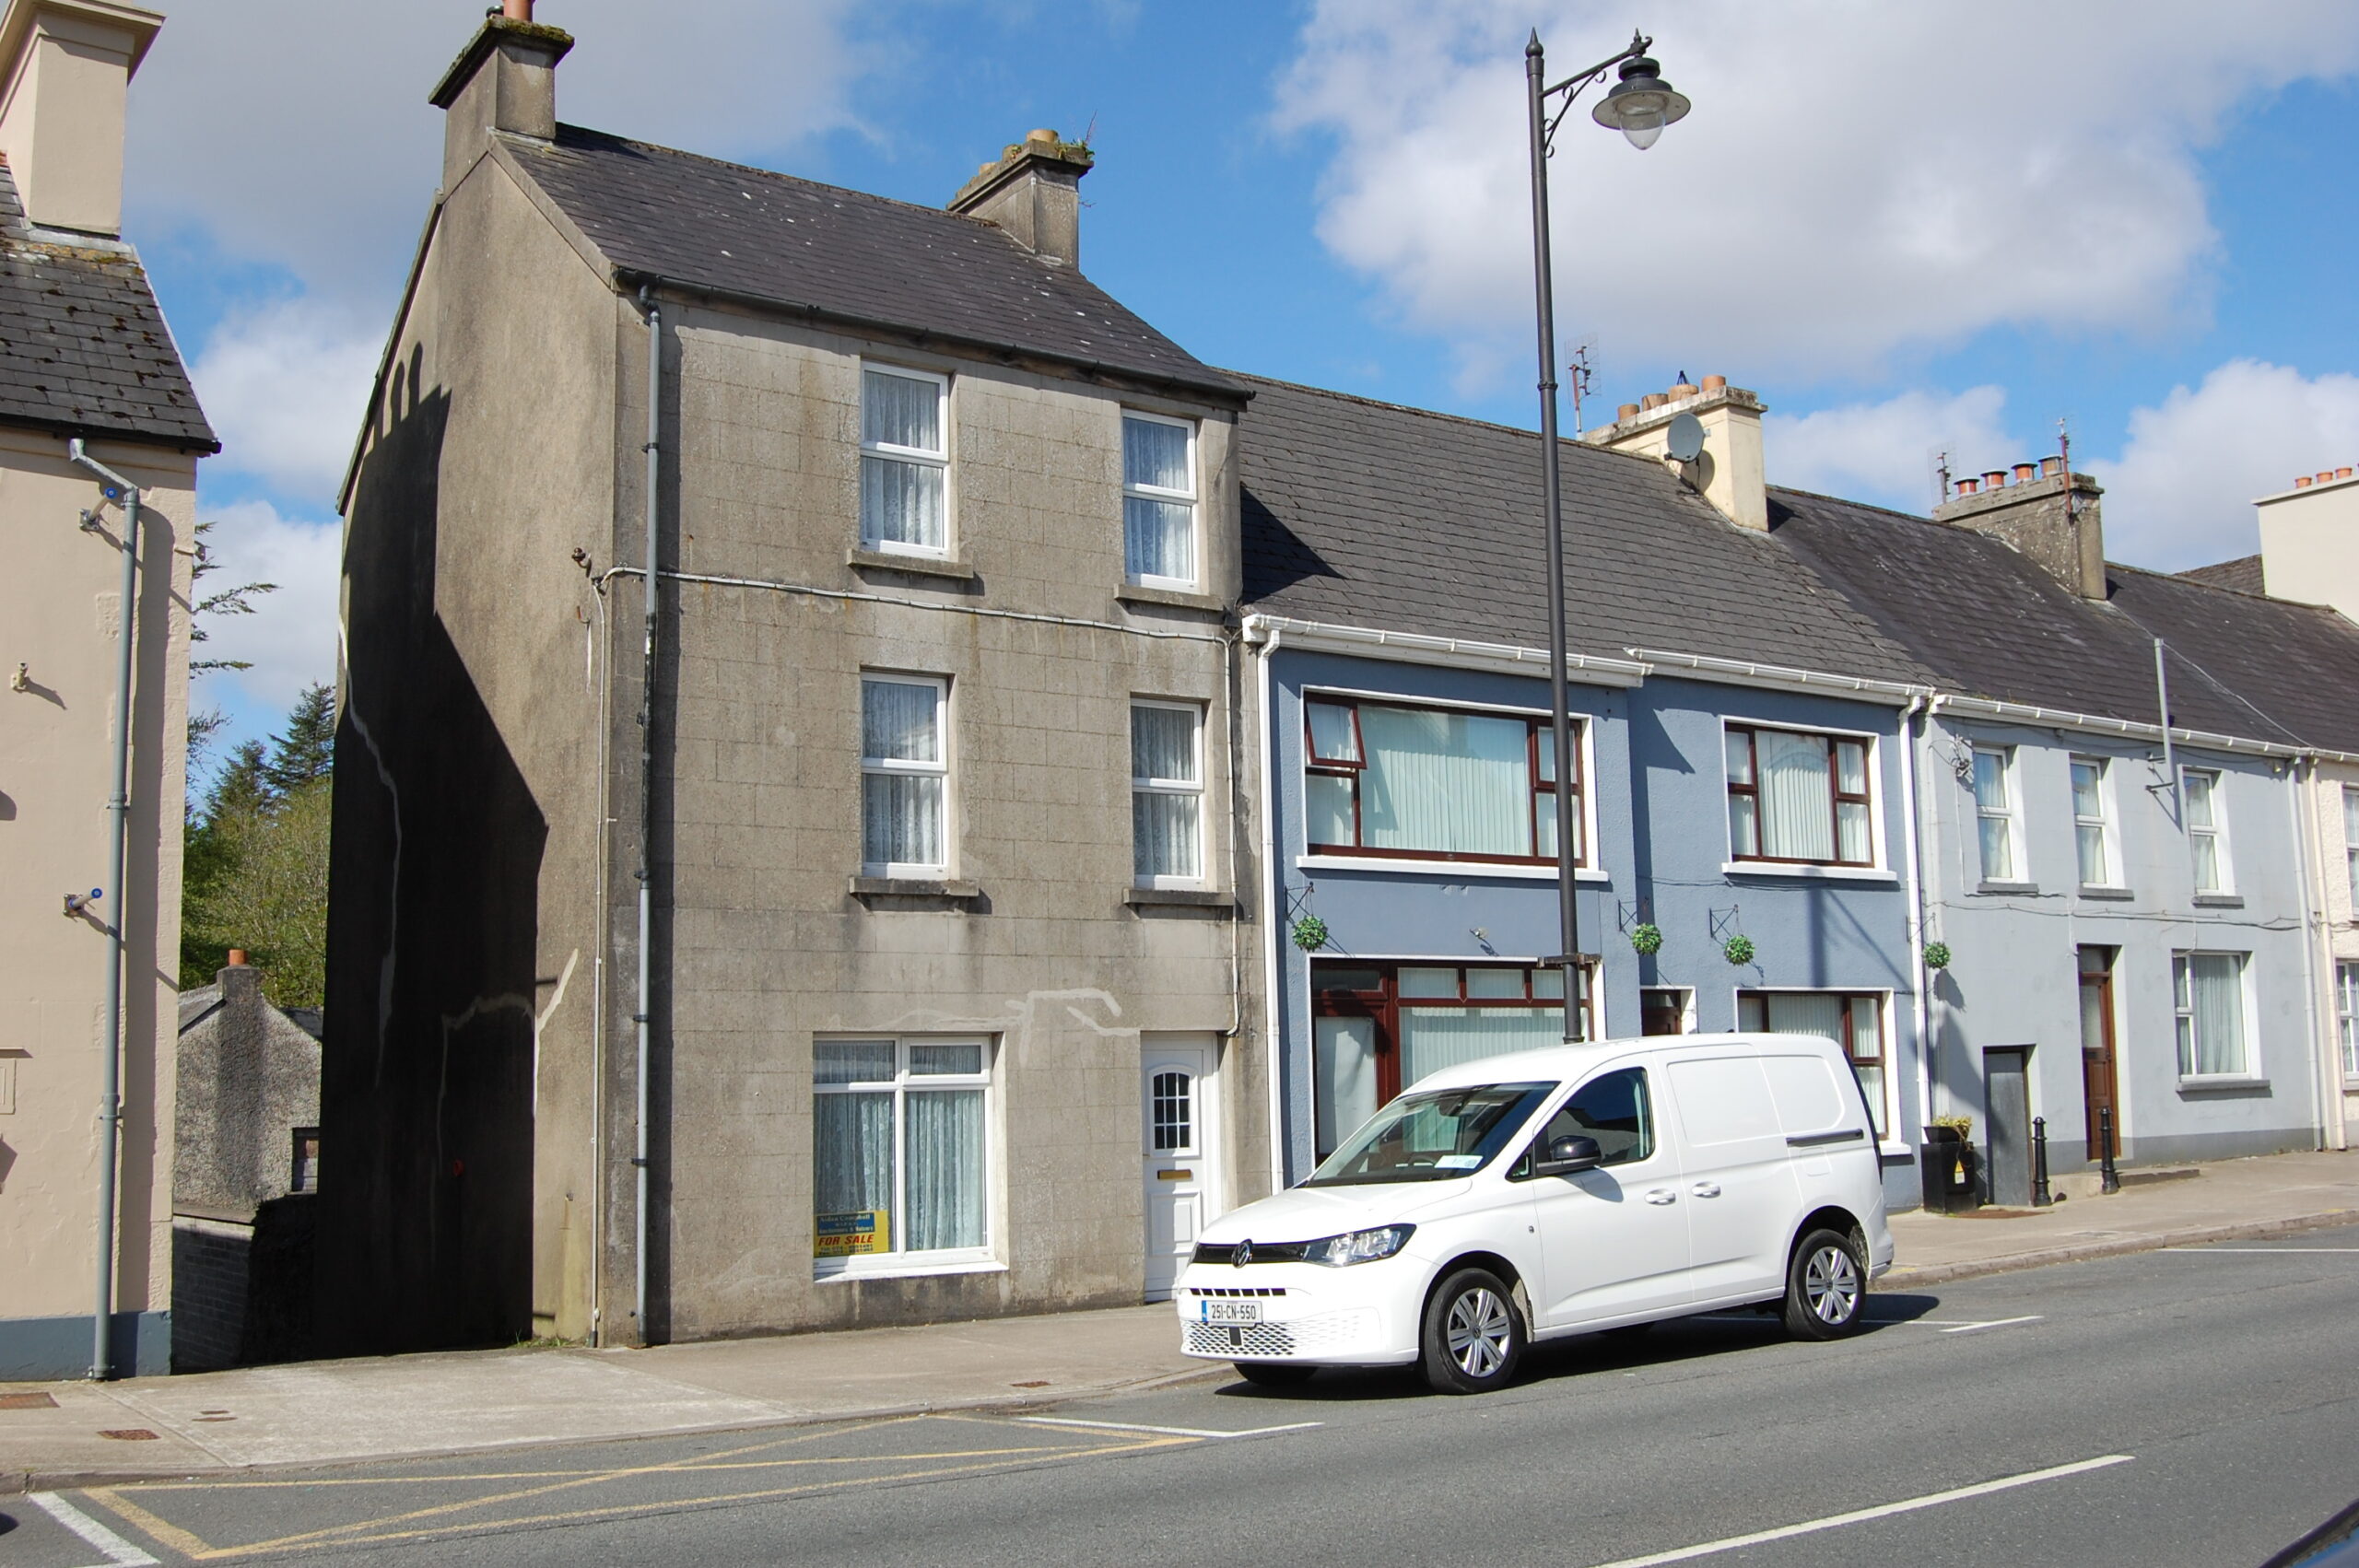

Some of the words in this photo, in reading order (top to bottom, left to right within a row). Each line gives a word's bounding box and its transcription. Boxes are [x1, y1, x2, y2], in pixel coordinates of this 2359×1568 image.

[818, 1236, 840, 1246] FOR
[844, 1235, 874, 1245] SALE
[1212, 1305, 1256, 1319] 251-CN-550
